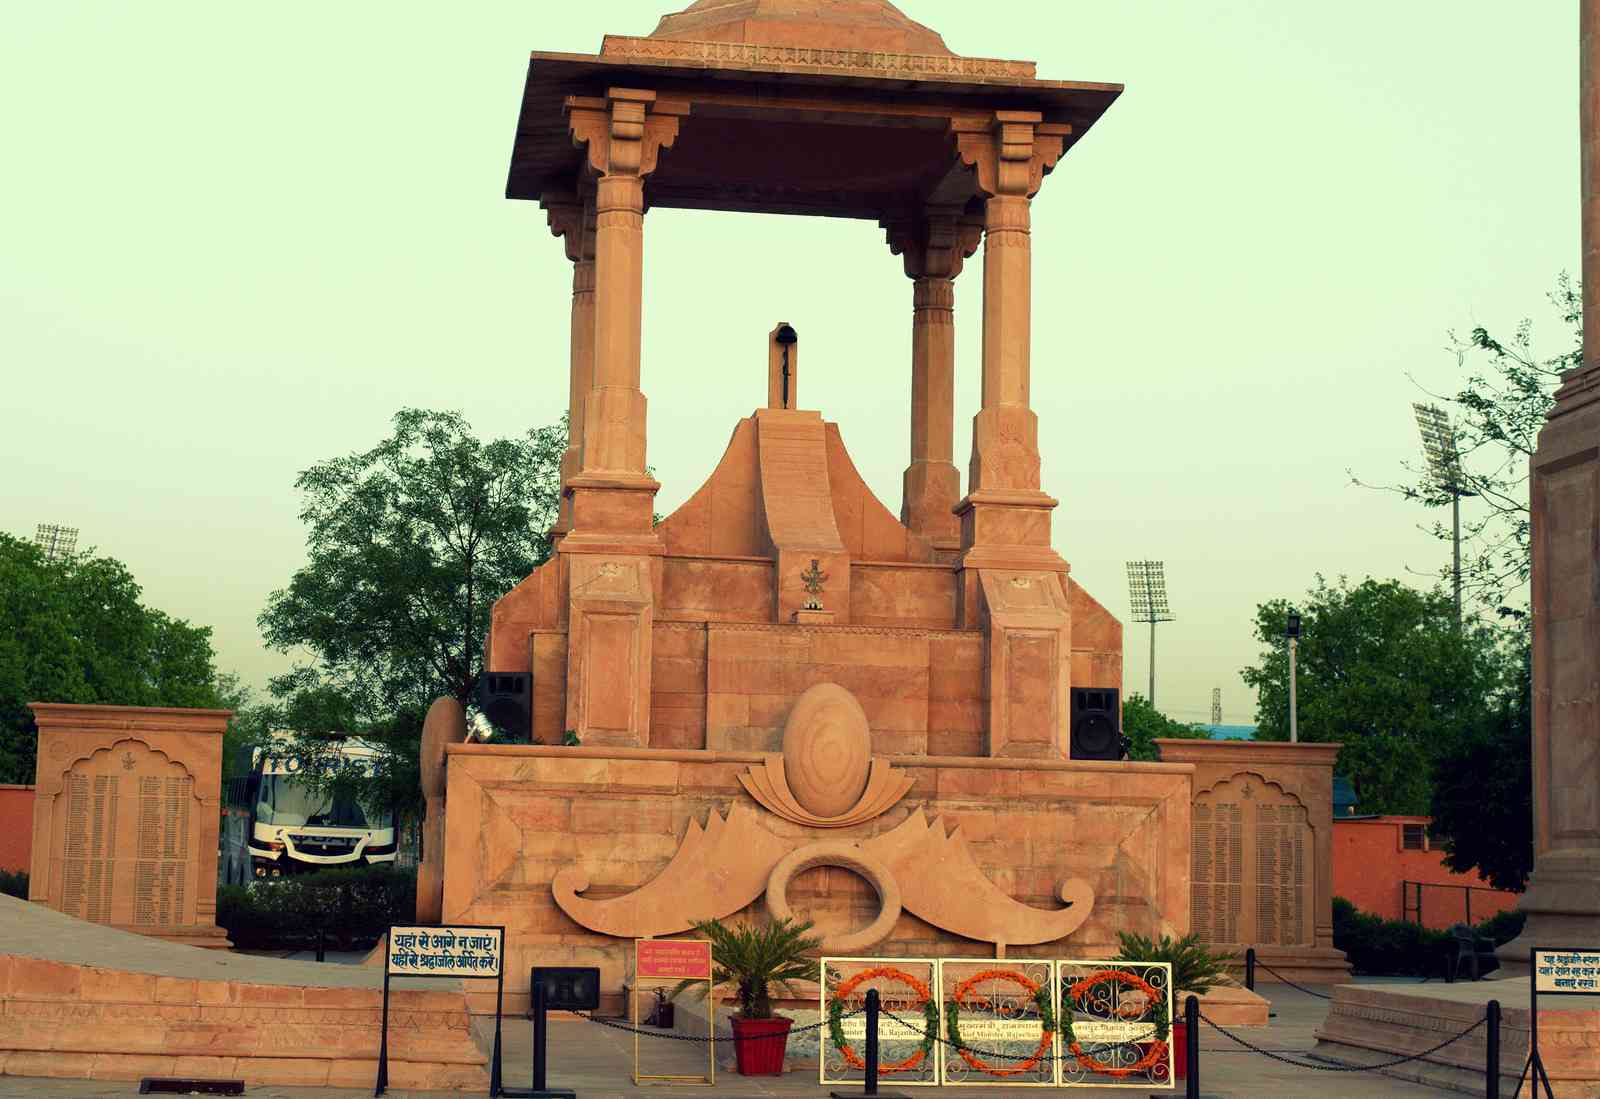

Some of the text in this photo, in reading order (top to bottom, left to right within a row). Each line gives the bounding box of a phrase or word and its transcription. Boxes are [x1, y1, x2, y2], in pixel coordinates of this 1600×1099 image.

[395, 932, 417, 948] यहां
[418, 931, 430, 950] से
[431, 930, 456, 949] आगे
